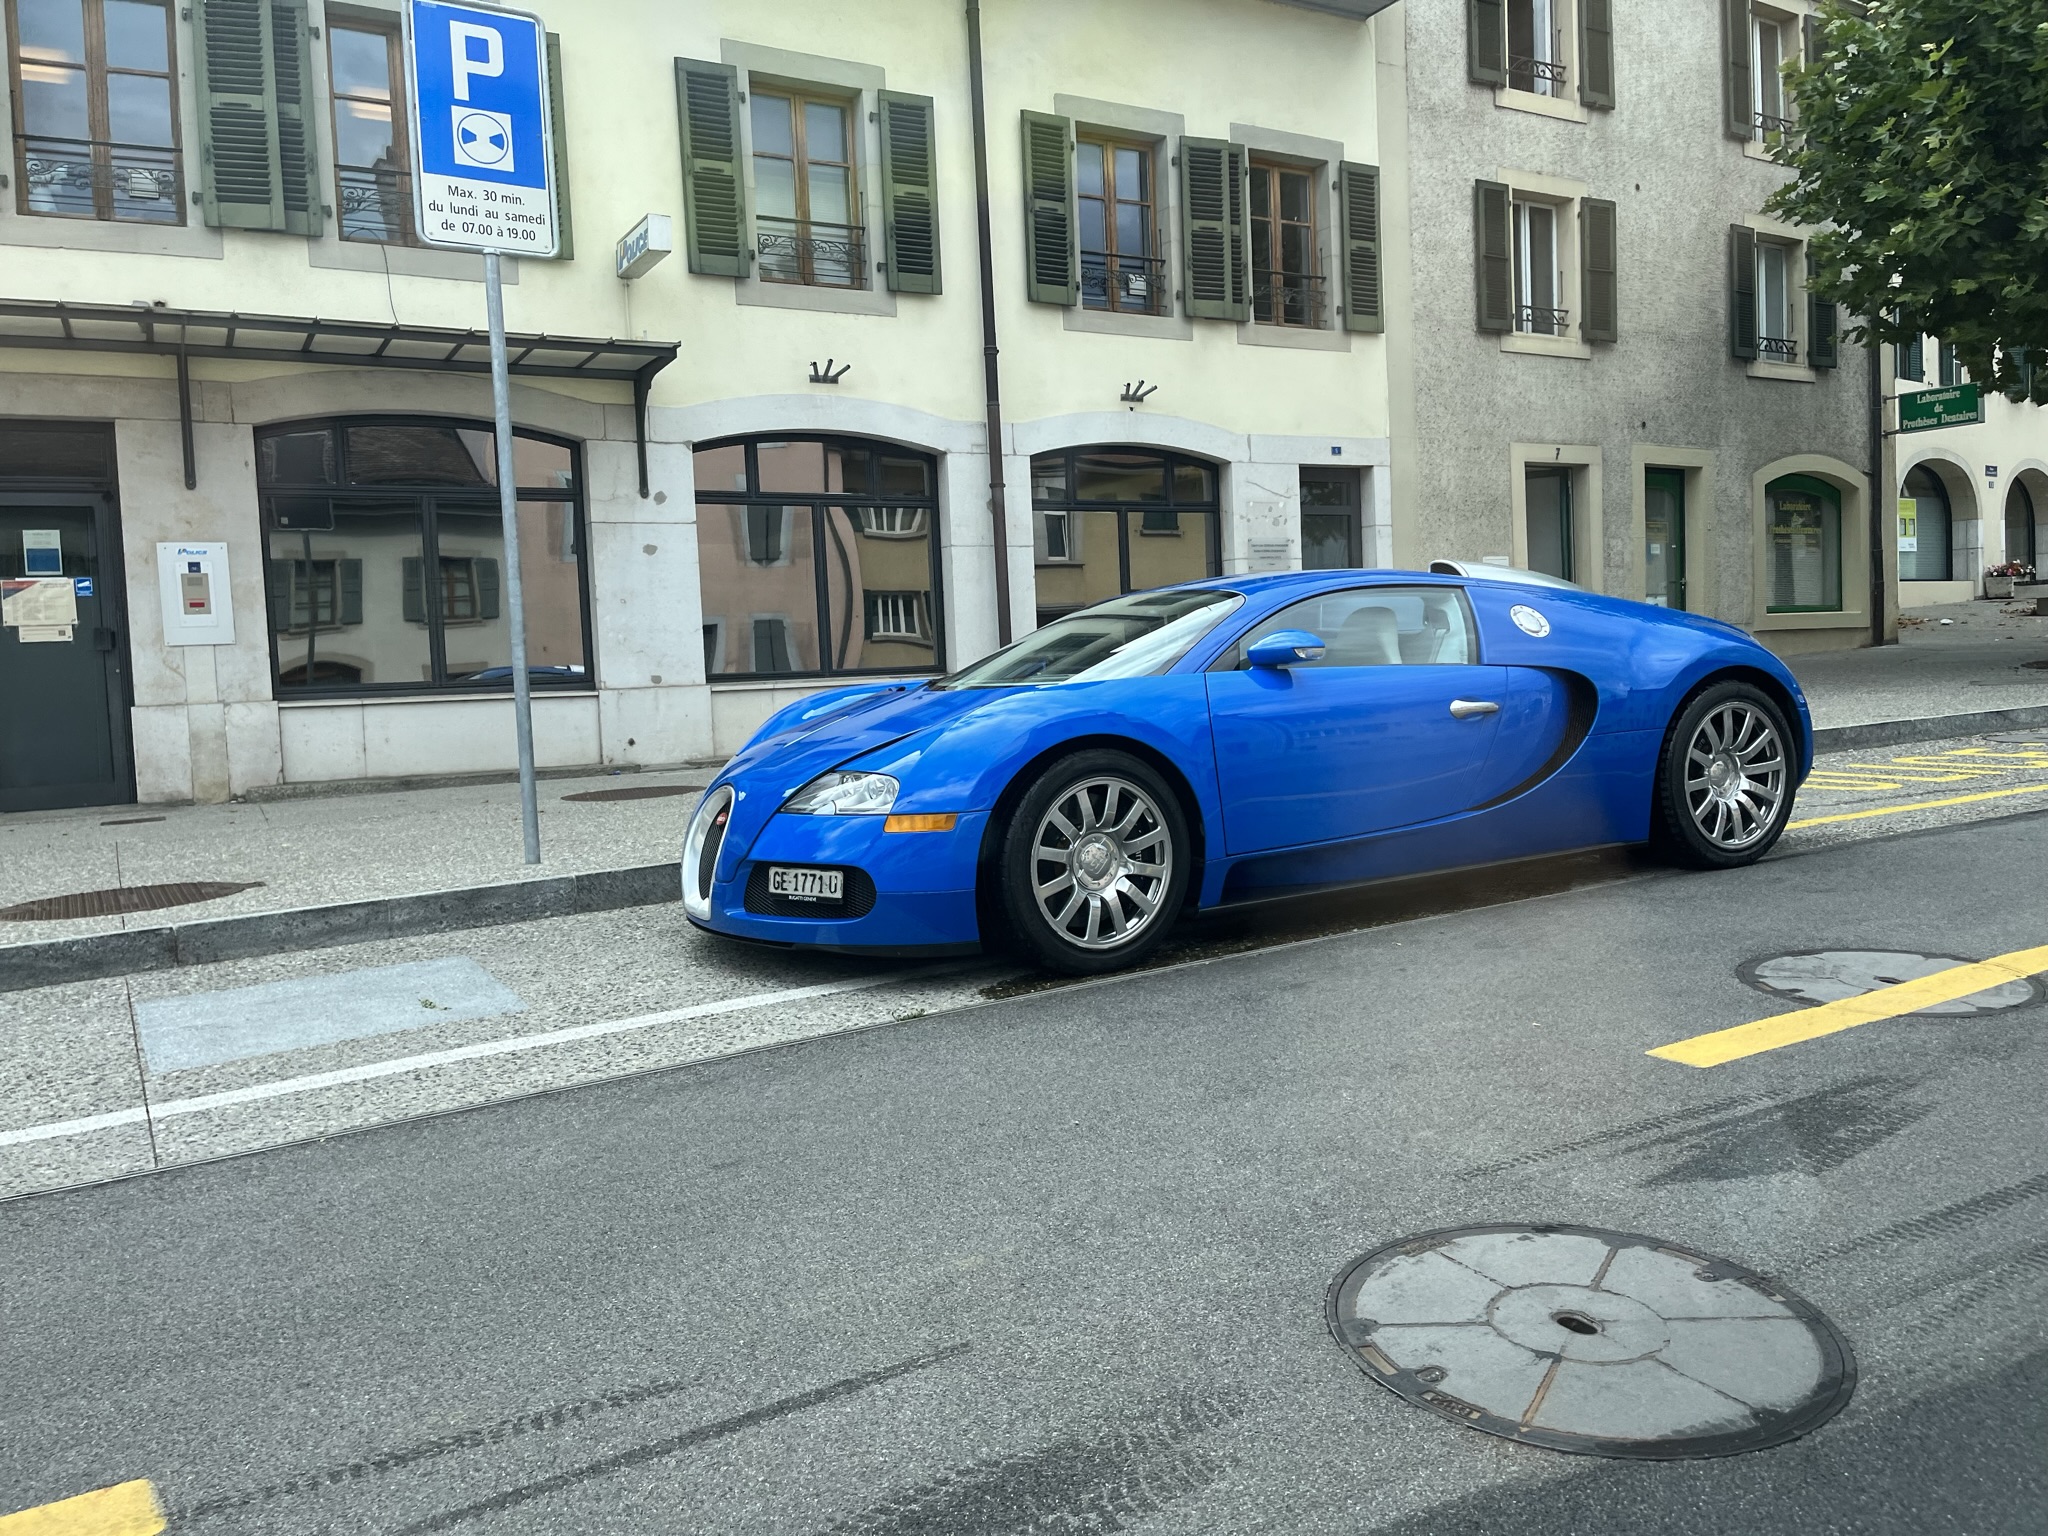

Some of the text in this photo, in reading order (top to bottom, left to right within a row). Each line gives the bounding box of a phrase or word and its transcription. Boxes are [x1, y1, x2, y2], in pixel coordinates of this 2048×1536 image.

[449, 20, 504, 101] P
[448, 185, 525, 206] Max. 30 min.
[428, 200, 546, 225] du lundi au samedi
[441, 219, 536, 241] de 07.00 à 19.00
[1917, 389, 1961, 404] Laboratoire
[1934, 402, 1944, 413] de
[1941, 410, 1977, 423] Dentaires
[1555, 447, 1561, 460] 7
